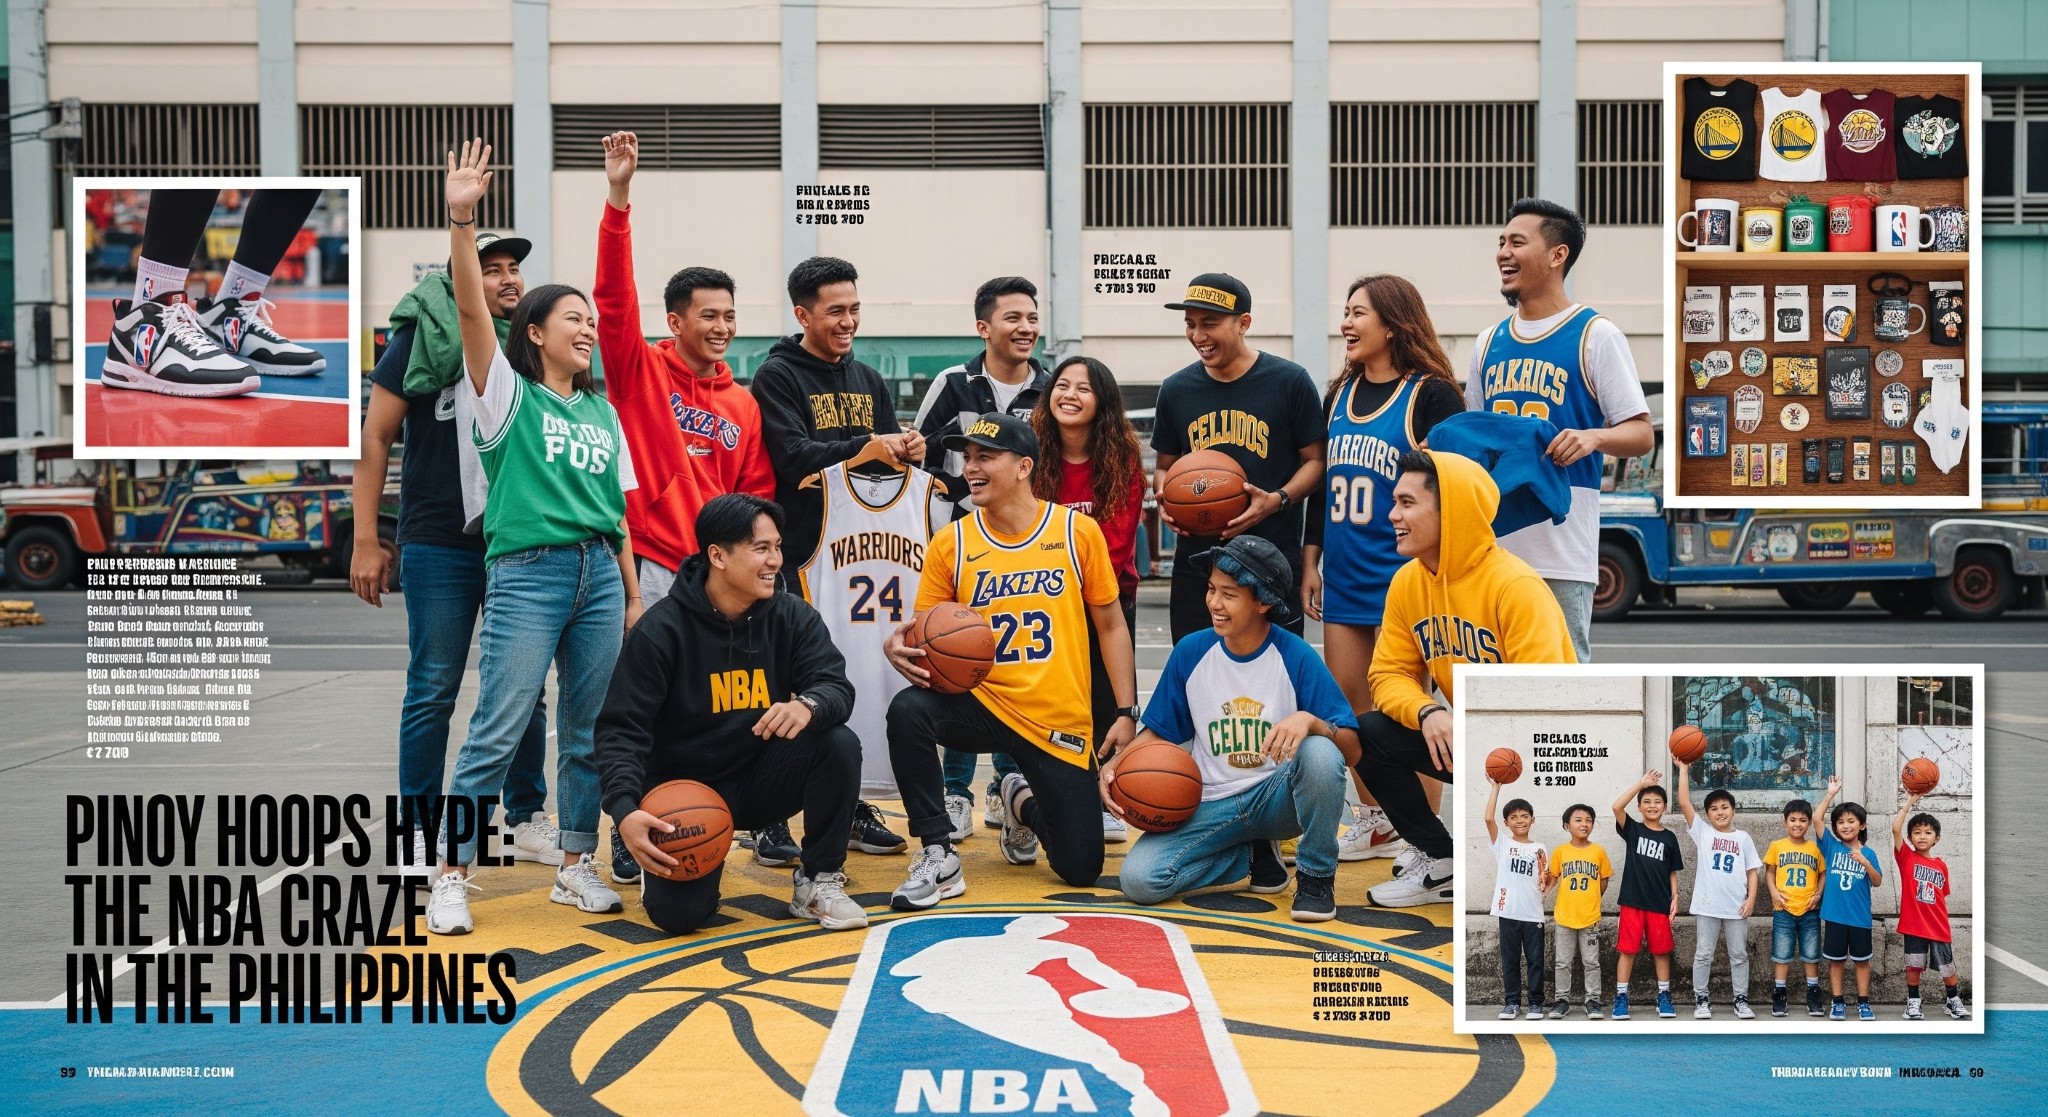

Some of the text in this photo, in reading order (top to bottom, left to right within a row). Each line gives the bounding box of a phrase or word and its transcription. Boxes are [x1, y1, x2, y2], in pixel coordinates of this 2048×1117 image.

[1330, 475, 1374, 525] 30
[830, 532, 924, 573] WARRIORS
[849, 575, 903, 623] 24
[969, 568, 1065, 608] LAKERS
[991, 610, 1054, 664] 23
[710, 668, 771, 713] NBA
[1510, 858, 1535, 877] NBA
[1637, 836, 1665, 861] NBA
[894, 1068, 1098, 1114] NBA
